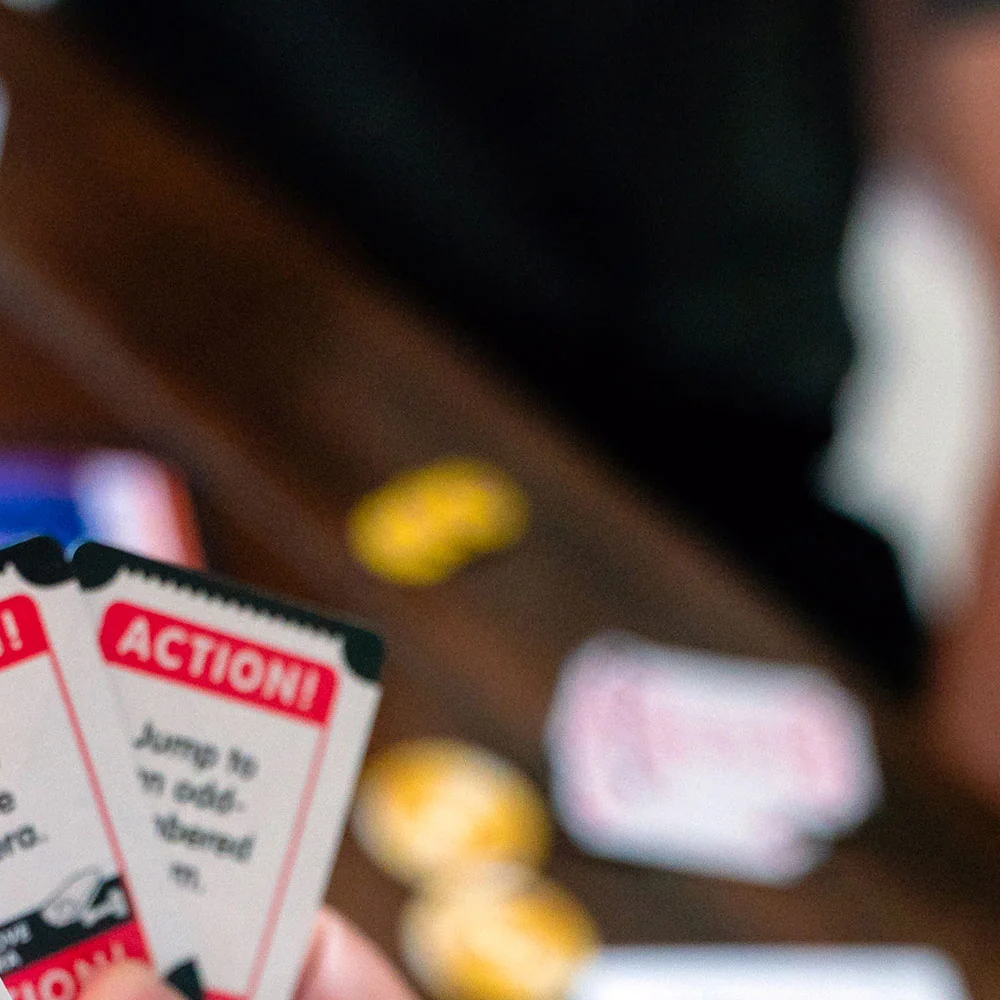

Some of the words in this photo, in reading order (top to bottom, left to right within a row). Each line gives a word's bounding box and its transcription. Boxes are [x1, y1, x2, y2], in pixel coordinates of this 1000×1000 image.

[115, 615, 321, 711] ACTION!
[132, 718, 219, 771] Jump
[227, 745, 260, 782] to
[154, 811, 256, 864] bered
